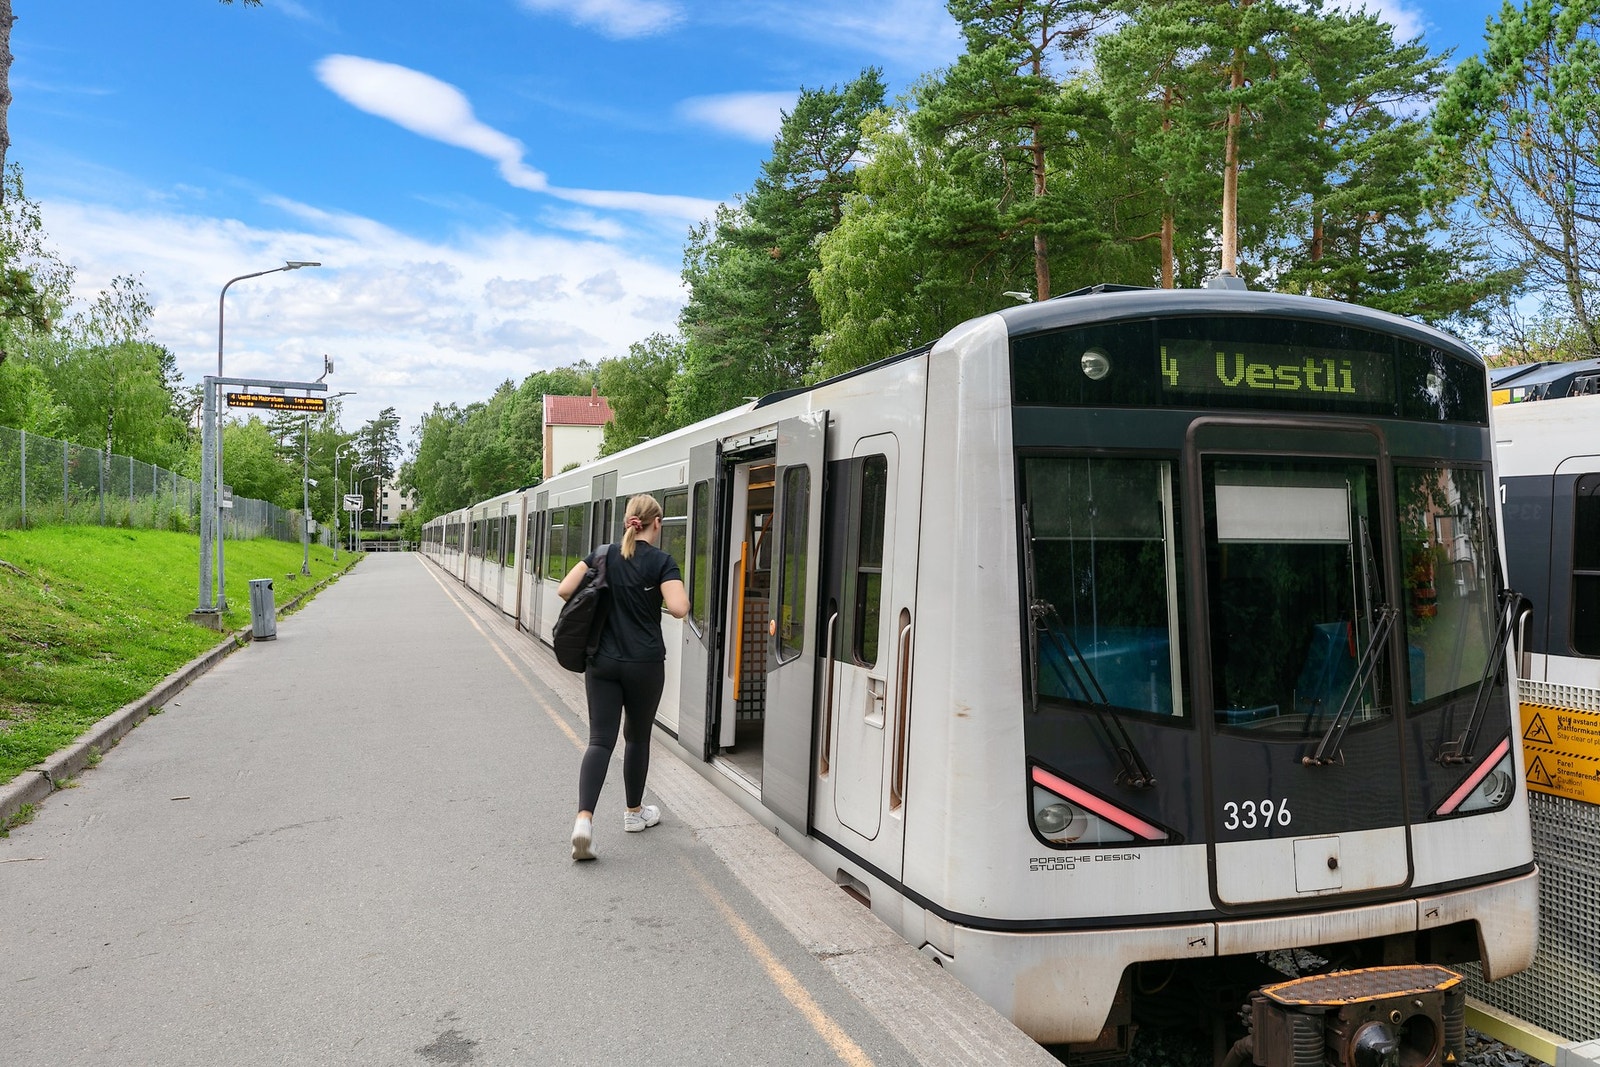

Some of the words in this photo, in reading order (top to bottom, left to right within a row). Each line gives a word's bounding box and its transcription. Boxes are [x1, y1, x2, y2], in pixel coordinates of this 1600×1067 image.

[1160, 346, 1179, 386] 4
[1216, 352, 1355, 393] Vestli
[1573, 718, 1598, 727] avstand
[1557, 732, 1570, 741] Stay
[1571, 735, 1586, 743] clear
[1557, 759, 1574, 768] Fare!
[1223, 798, 1292, 830] 3396
[1029, 855, 1091, 864] PORSCHE
[1094, 853, 1141, 862] DESIGN
[1029, 863, 1076, 872] STUDIO
